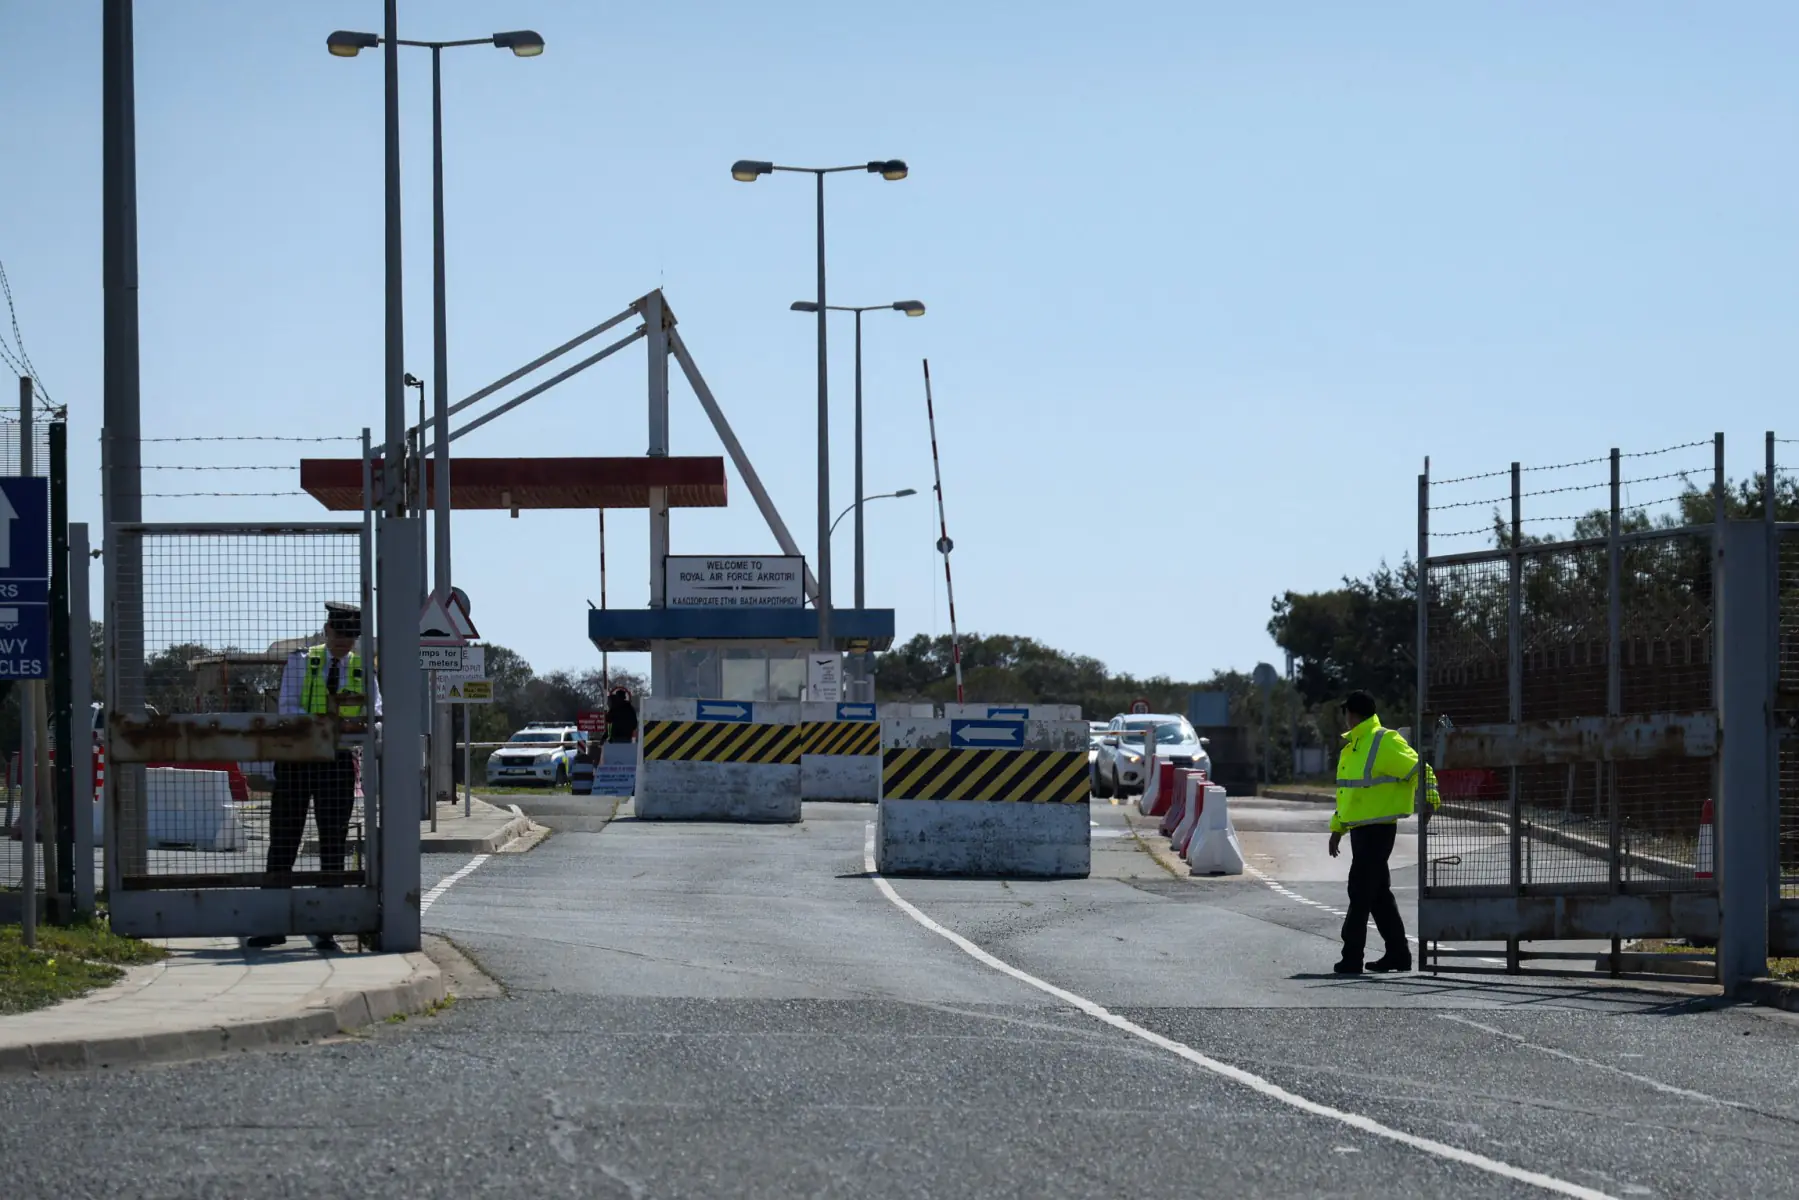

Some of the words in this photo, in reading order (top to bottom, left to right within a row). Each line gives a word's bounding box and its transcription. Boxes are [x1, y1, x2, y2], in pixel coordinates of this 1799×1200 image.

[706, 560, 748, 570] WELCOME
[751, 561, 762, 570] TO
[680, 572, 704, 581] ROYAL
[710, 572, 723, 581] AIR
[726, 572, 752, 581] FORCE
[757, 572, 795, 581] AKROTIRI
